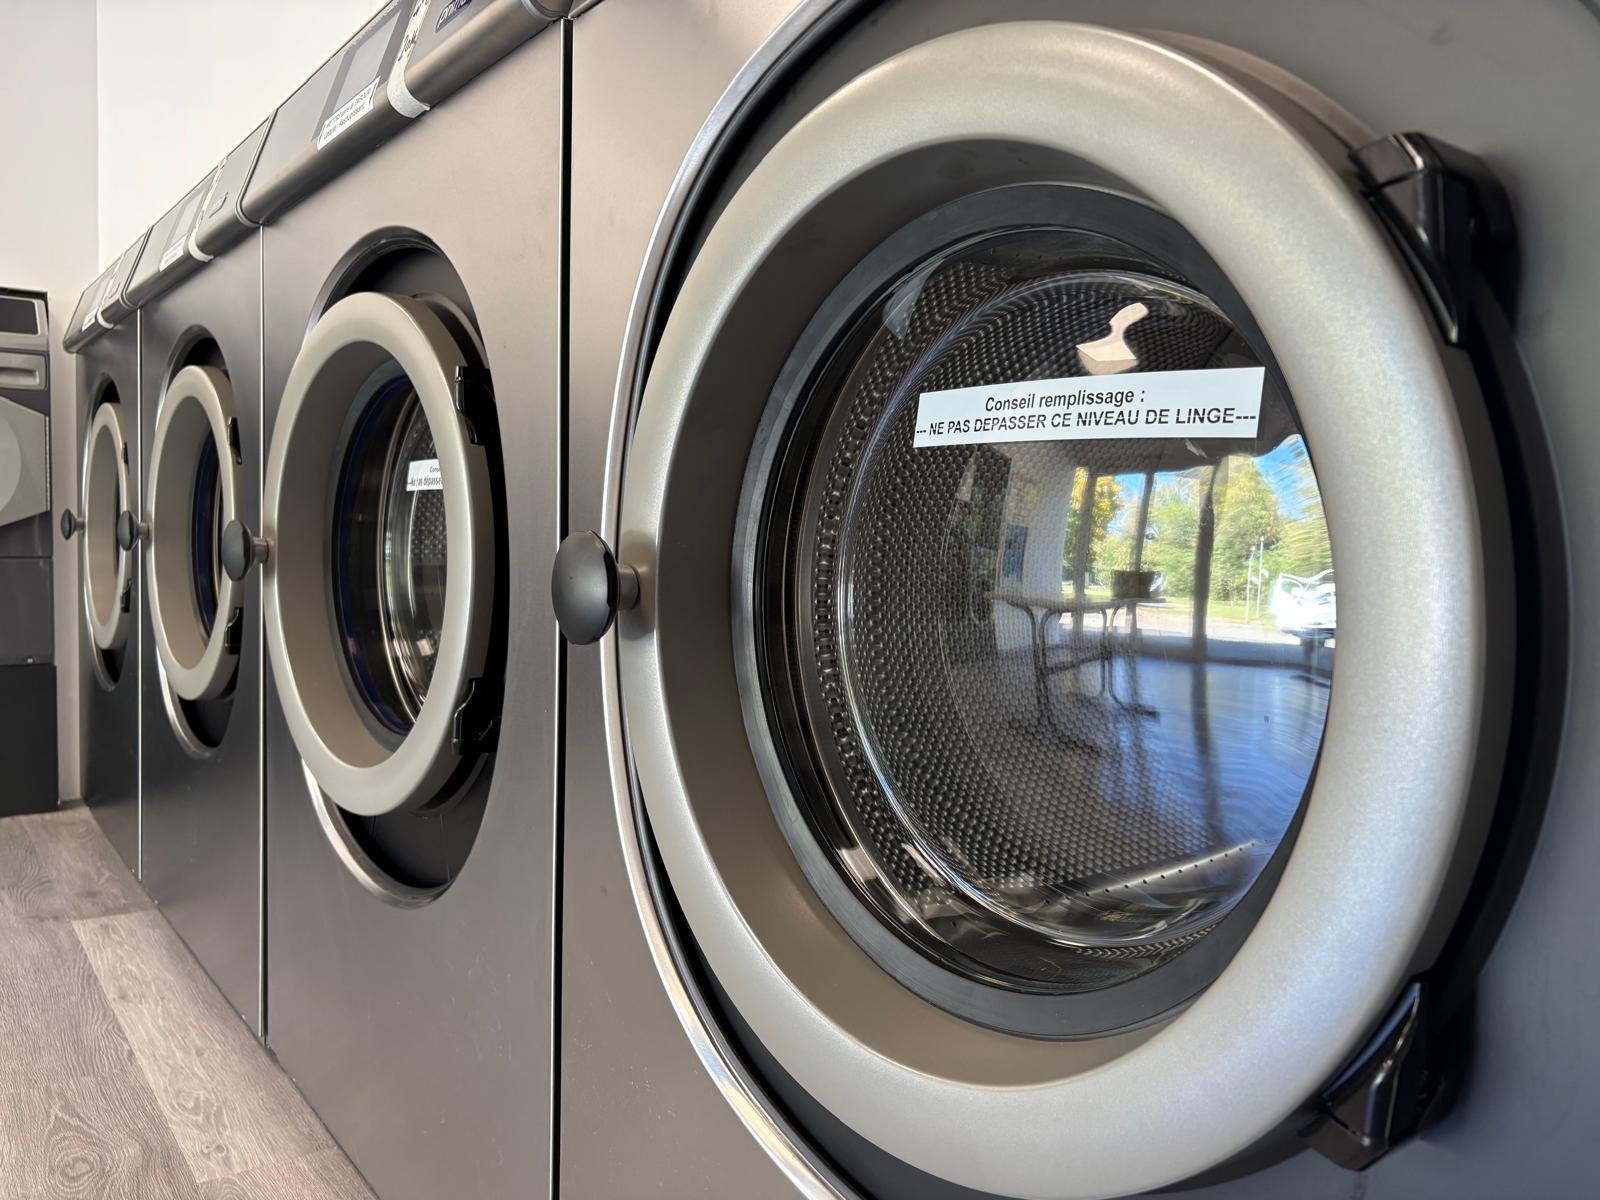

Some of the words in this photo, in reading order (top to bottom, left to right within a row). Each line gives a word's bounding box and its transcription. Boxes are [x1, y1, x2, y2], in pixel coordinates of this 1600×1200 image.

[985, 393, 1036, 412] Conseil
[1038, 389, 1135, 410] remplissage
[929, 421, 945, 436] NE
[947, 419, 970, 434] PAS
[973, 414, 1047, 432] DEPASSER
[1051, 412, 1072, 428] CE
[1076, 410, 1140, 427] NIVEAU
[1145, 408, 1170, 425] DE
